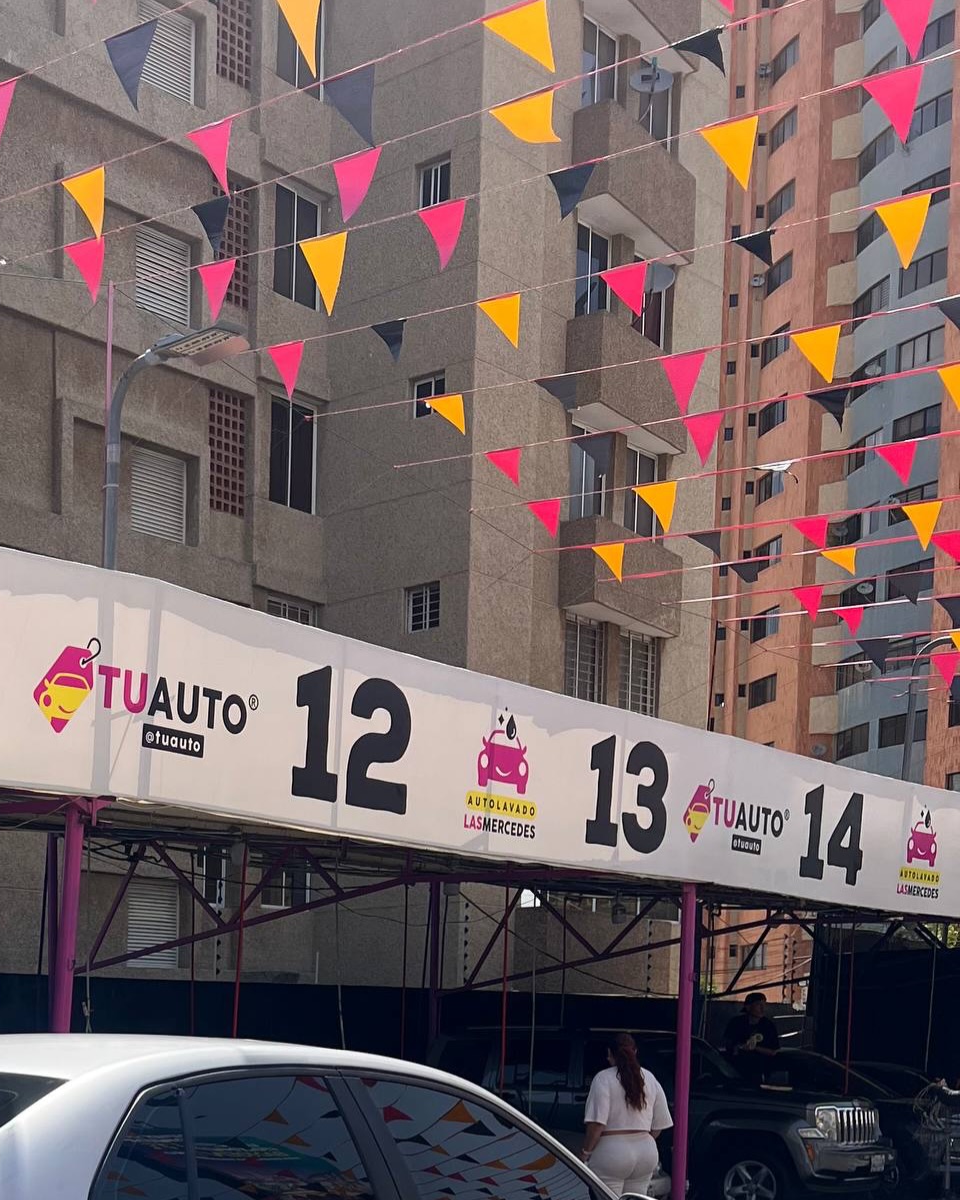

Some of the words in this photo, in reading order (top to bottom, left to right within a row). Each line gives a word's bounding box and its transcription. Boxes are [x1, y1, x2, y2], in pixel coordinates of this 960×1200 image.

[145, 731, 201, 753] @tuauto
[291, 666, 411, 815] 12
[468, 795, 535, 816] AUTOLAVADO
[585, 734, 669, 854] 13
[799, 784, 864, 886] 14
[900, 870, 940, 883] AUTOLAVADO
